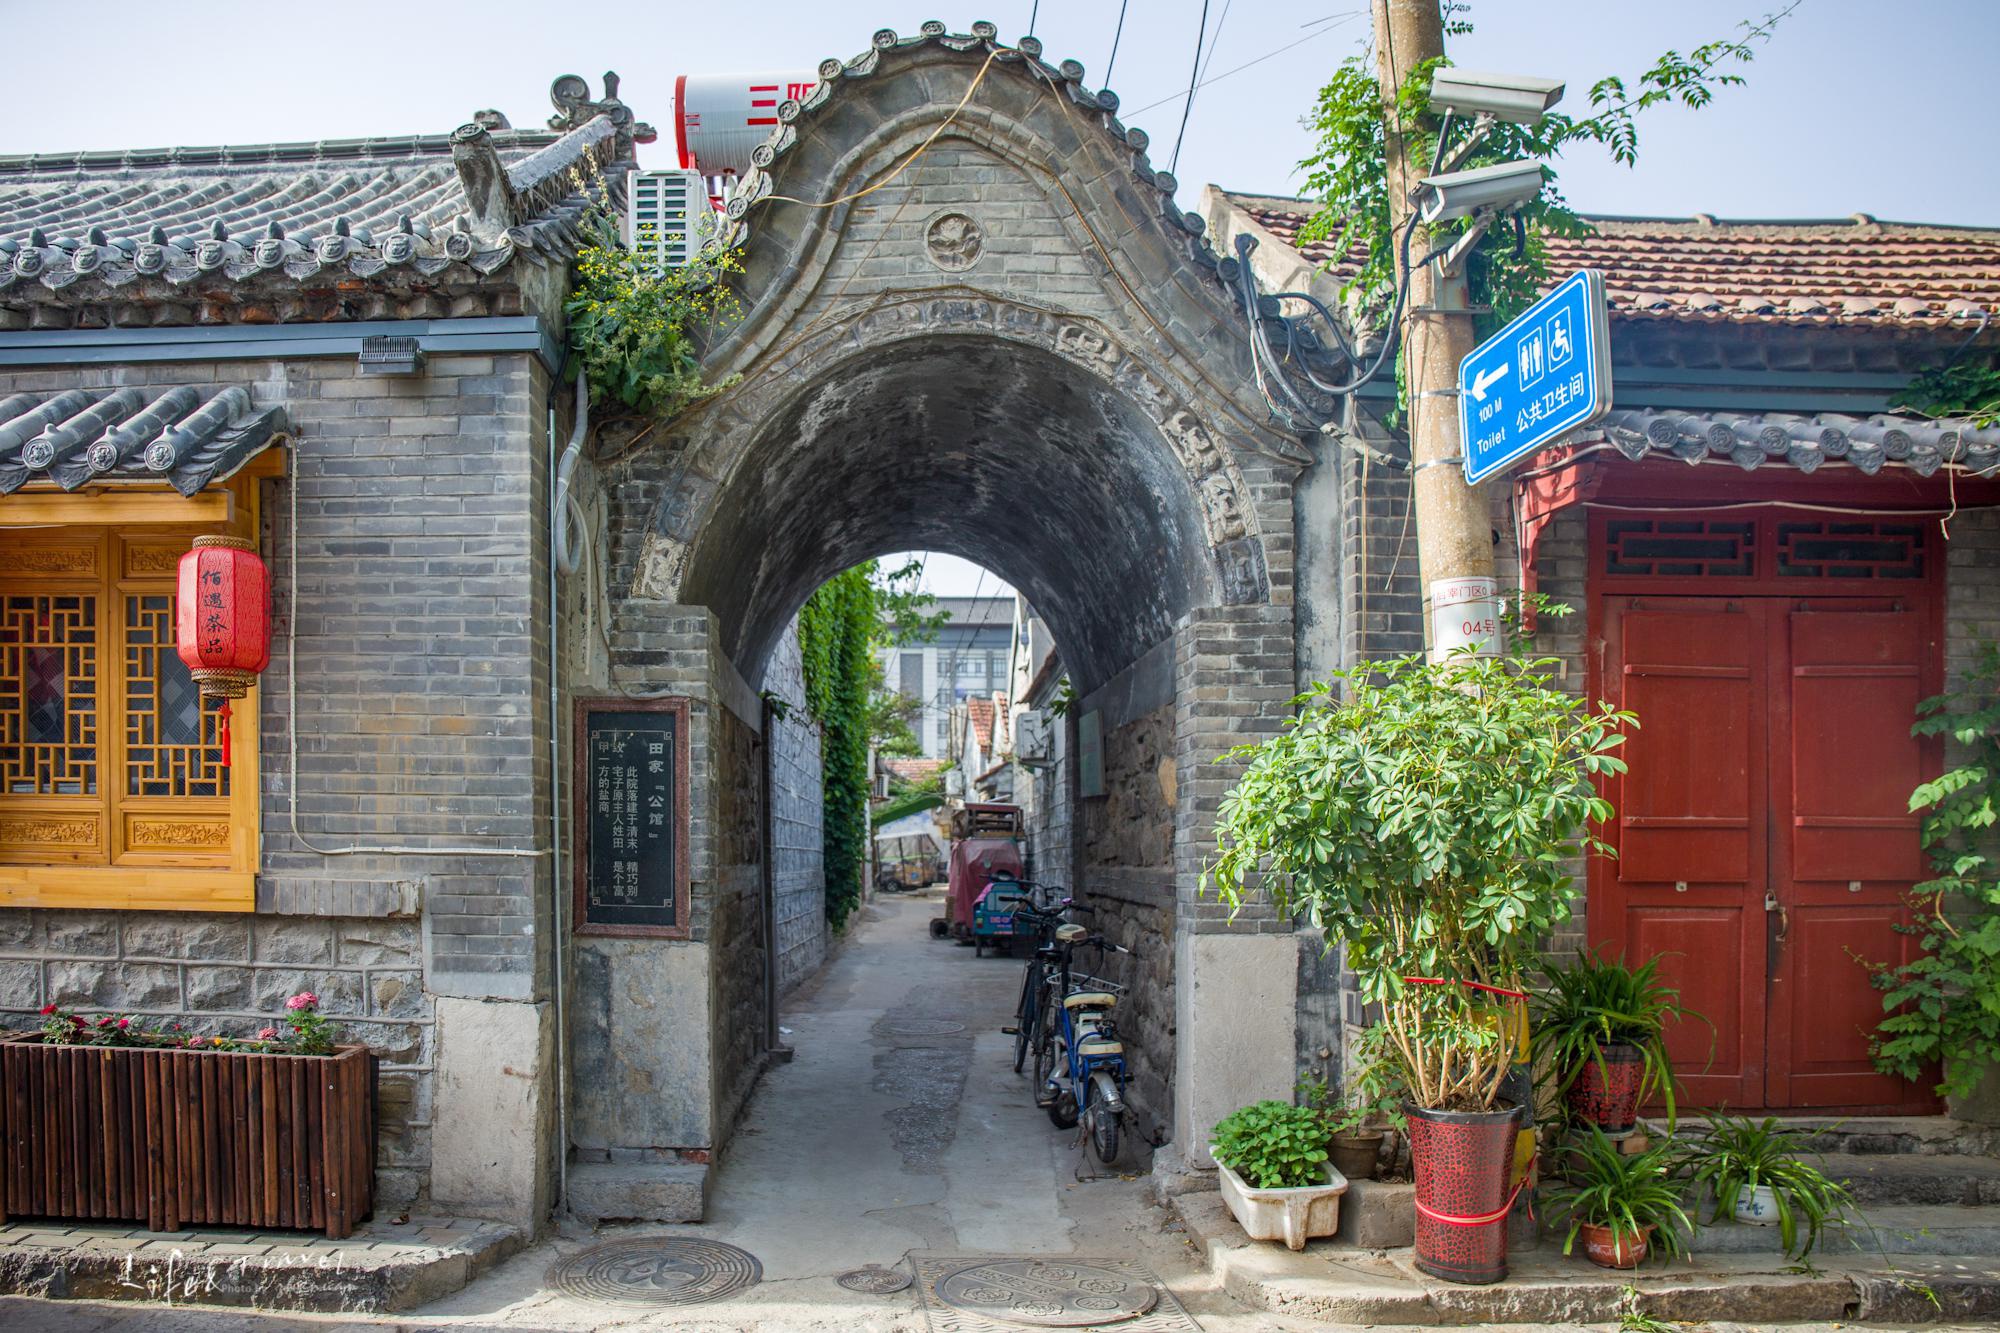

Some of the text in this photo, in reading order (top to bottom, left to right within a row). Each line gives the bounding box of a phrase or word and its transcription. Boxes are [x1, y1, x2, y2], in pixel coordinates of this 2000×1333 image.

[1478, 397, 1503, 424] 100 M
[1515, 371, 1585, 433] 公共卫生间
[1476, 426, 1506, 455] Toilet
[1462, 619, 1496, 637] 04号
